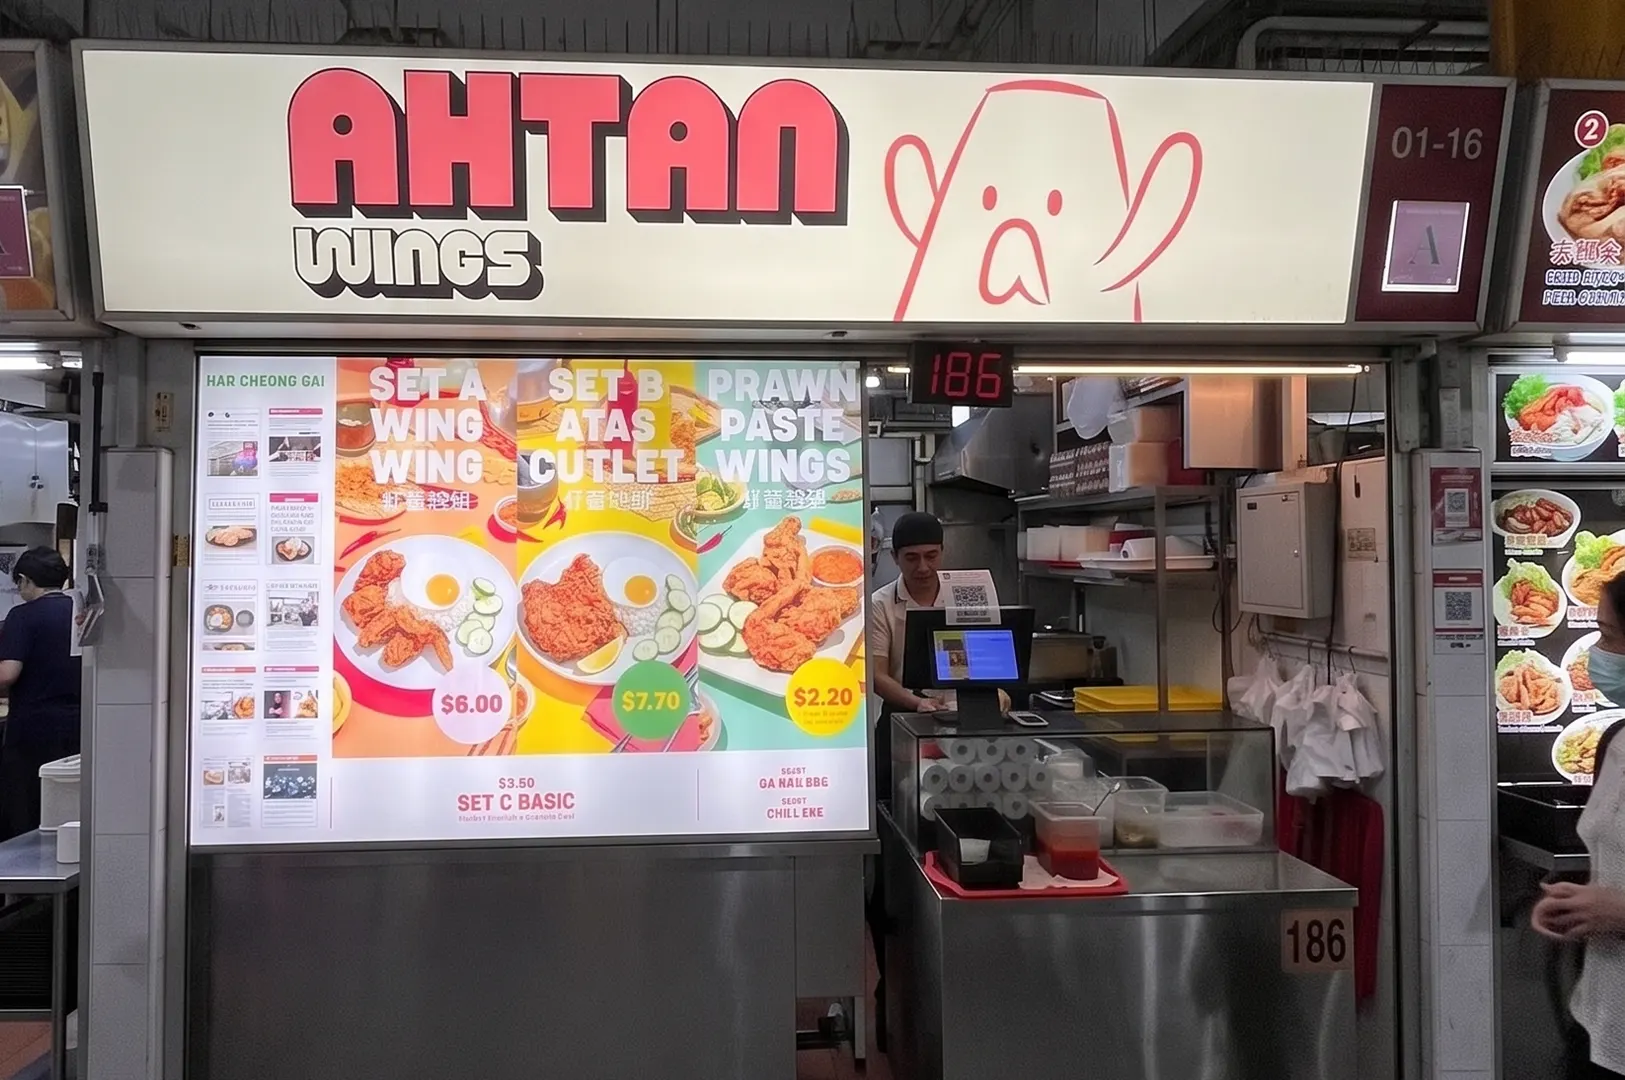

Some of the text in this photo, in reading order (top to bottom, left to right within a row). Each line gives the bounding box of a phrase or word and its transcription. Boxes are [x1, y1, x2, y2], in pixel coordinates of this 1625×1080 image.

[288, 67, 848, 225] AHTAN
[1391, 126, 1483, 160] 01-16
[1584, 118, 1601, 141] 2
[1408, 224, 1441, 265] A
[294, 226, 543, 300] WINGS
[206, 374, 325, 388] HAR CHEONG GAI
[369, 367, 487, 401] SET A
[549, 367, 664, 402] SET B
[708, 368, 857, 402] PRAWN
[931, 351, 1003, 399] 186
[370, 408, 484, 443] WING
[555, 408, 656, 443] ATAS
[721, 409, 844, 442] PASTE
[370, 449, 483, 484] WING
[529, 449, 685, 484] CUTLET
[715, 448, 851, 484] WINGS
[440, 694, 503, 716] $6.00
[622, 690, 681, 711] $7.70
[794, 687, 853, 707] $2.20
[498, 777, 535, 790] $3.50
[457, 792, 576, 812] SET C BASIC
[1287, 919, 1346, 963] 186
